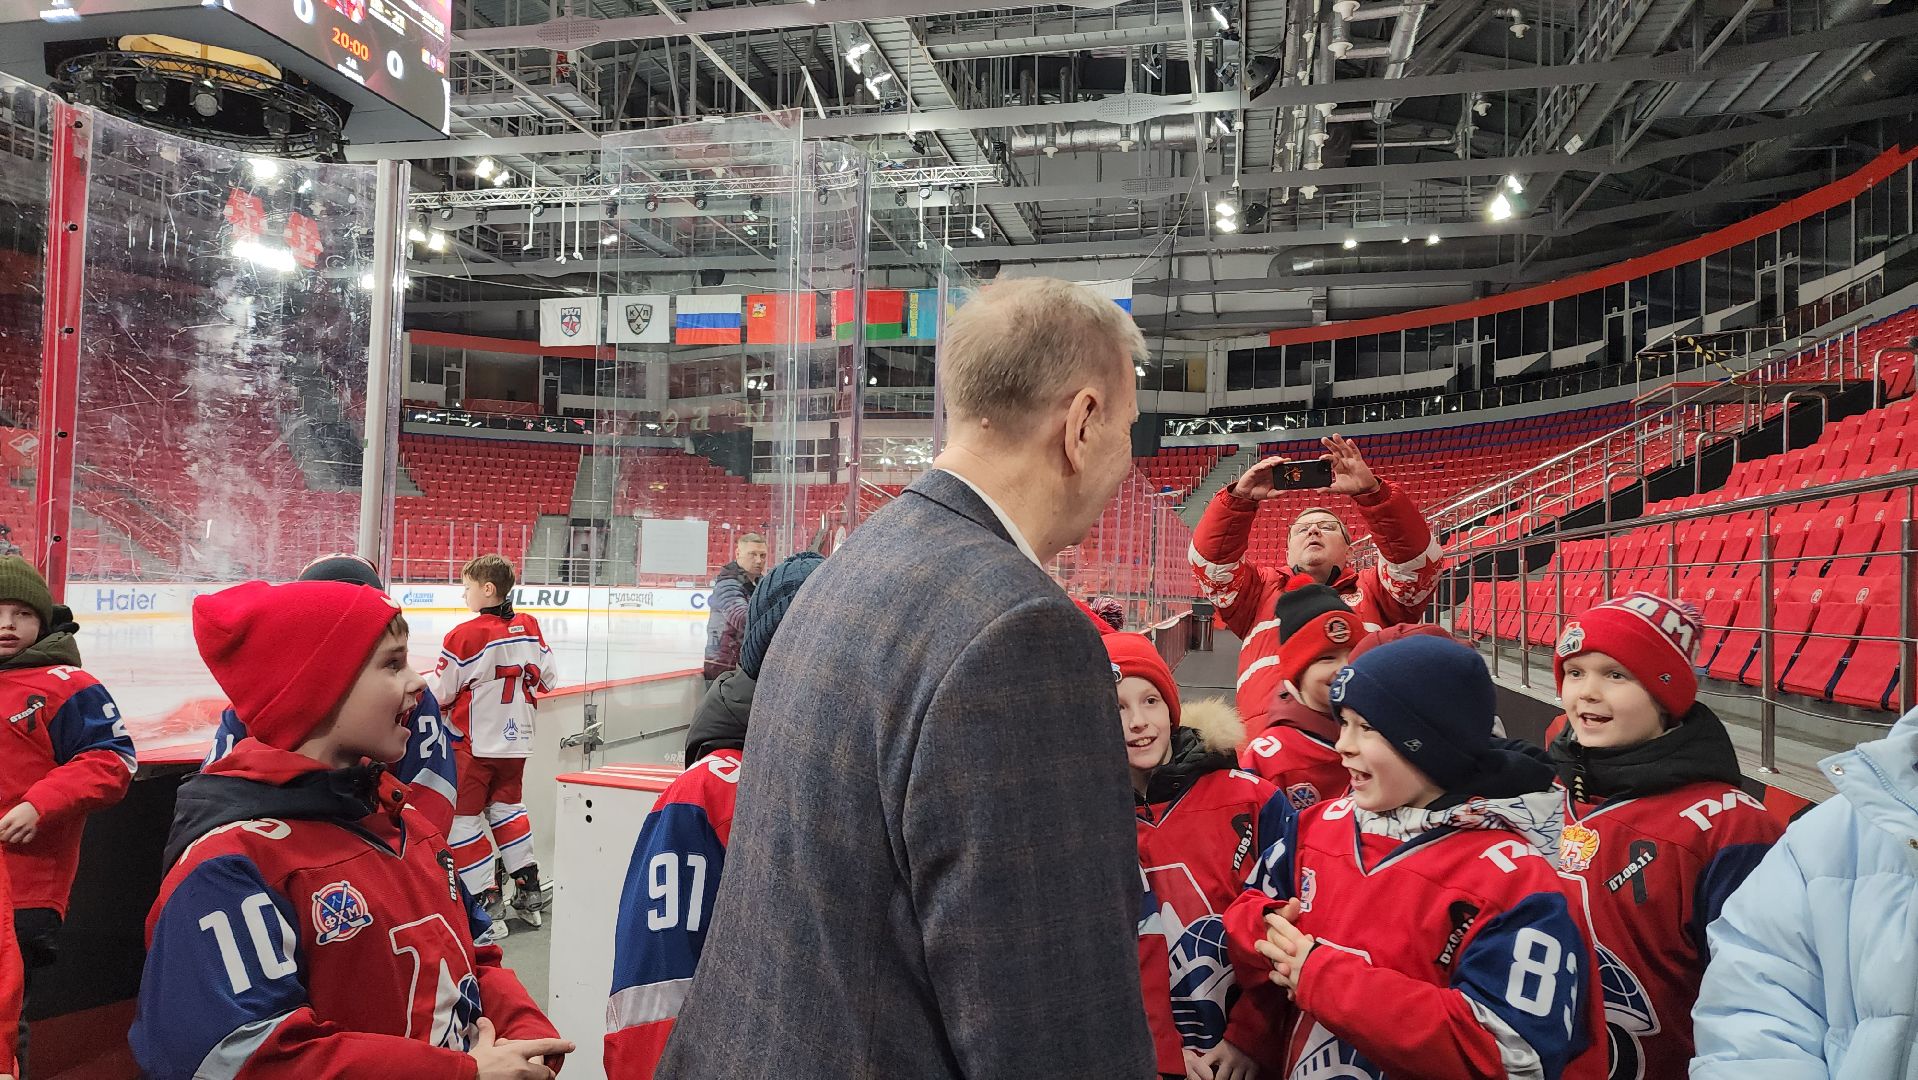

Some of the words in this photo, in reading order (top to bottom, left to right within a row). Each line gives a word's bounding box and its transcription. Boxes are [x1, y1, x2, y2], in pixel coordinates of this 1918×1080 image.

[332, 26, 369, 61] 20:00
[386, 50, 404, 80] 0
[96, 588, 157, 611] Haier
[1561, 839, 1585, 864] 75
[1608, 851, 1654, 892] 07.09.11
[647, 852, 707, 932] 91
[325, 904, 360, 929] ФХМ
[199, 892, 298, 995] 10
